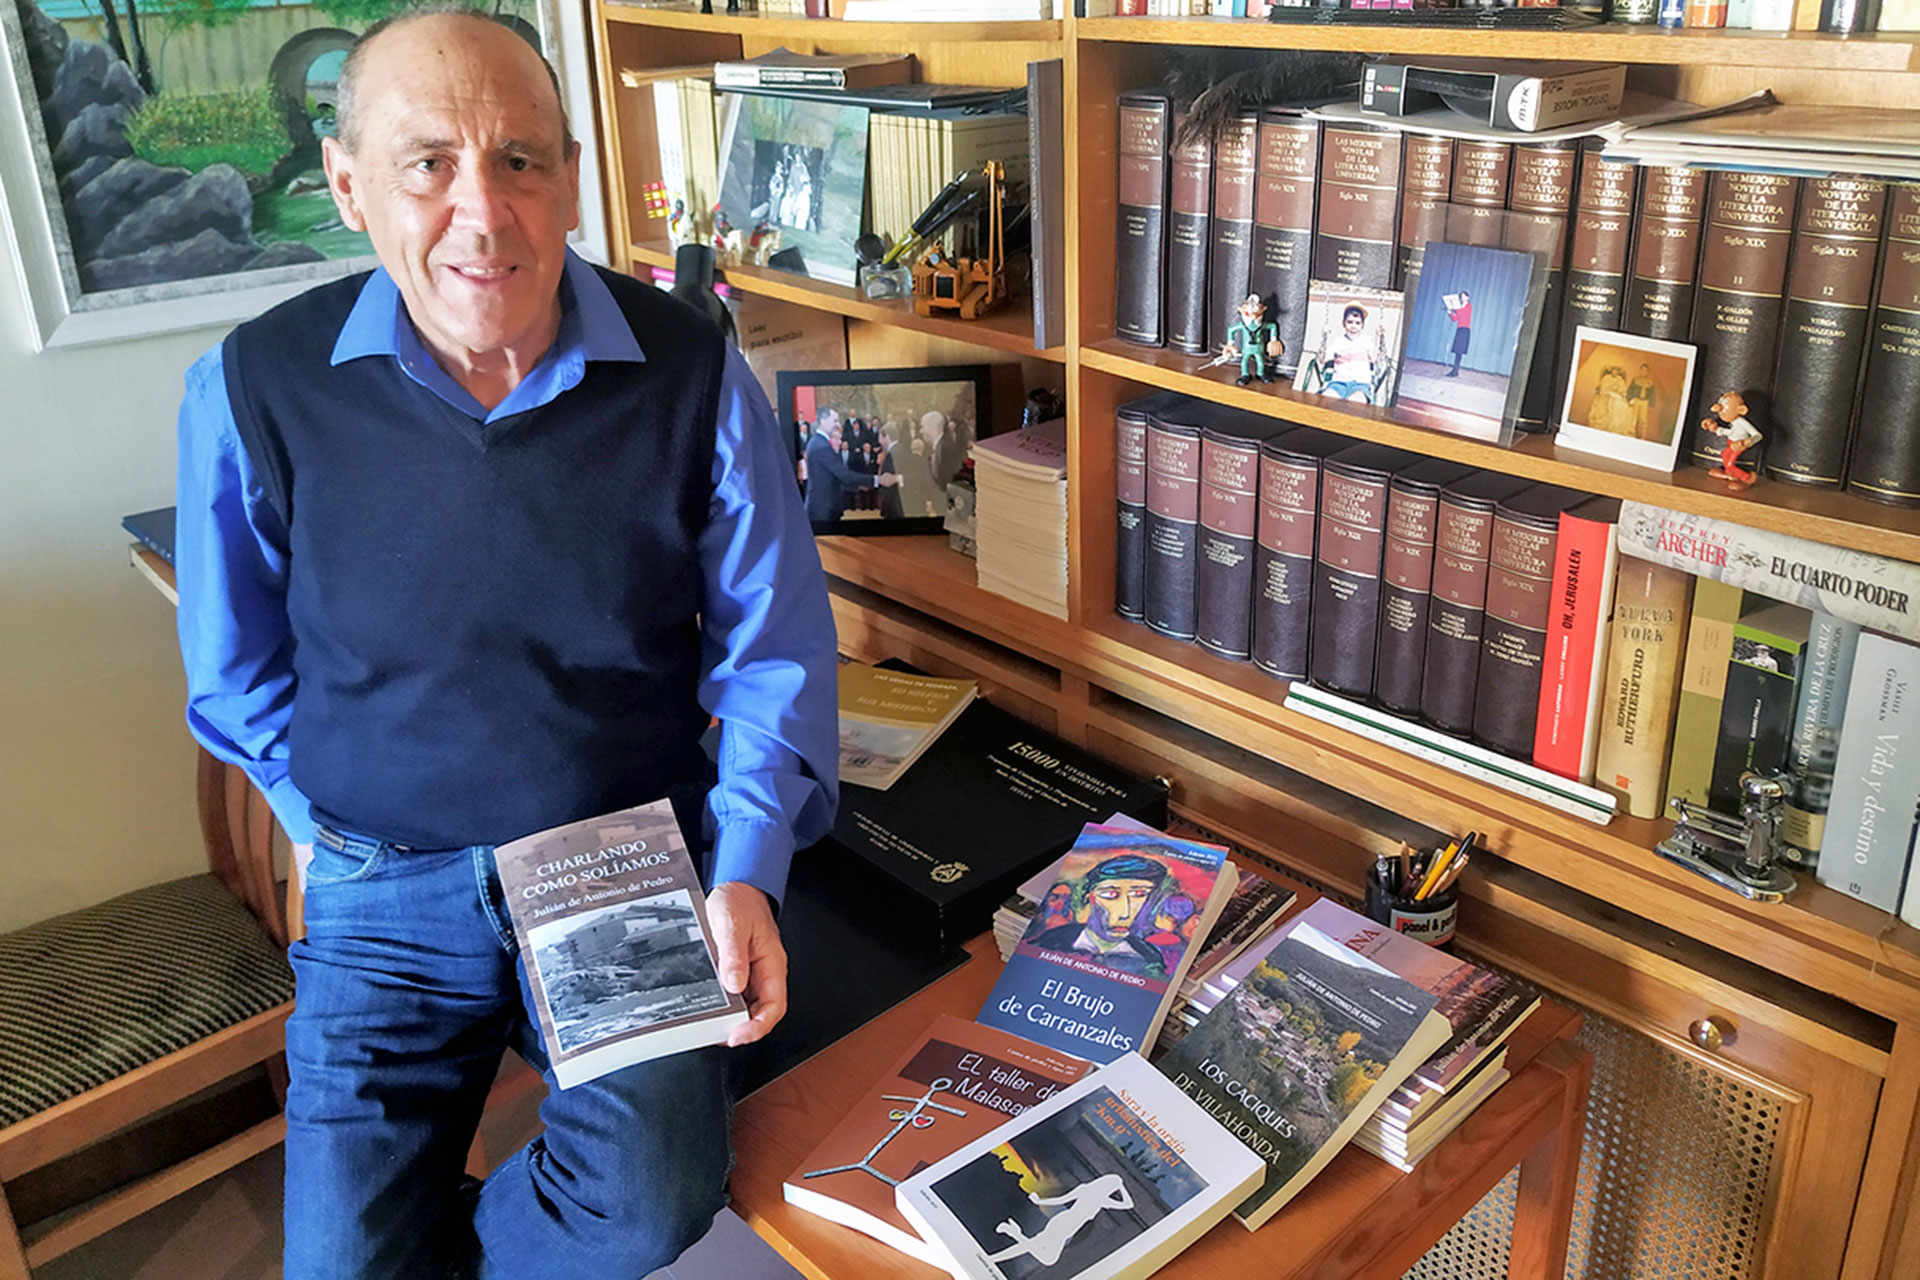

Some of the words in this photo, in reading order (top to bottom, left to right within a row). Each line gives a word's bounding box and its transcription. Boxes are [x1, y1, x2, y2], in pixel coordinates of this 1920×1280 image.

[1342, 148, 1374, 156] NOVELAS
[1350, 139, 1382, 149] MEJORES
[1334, 162, 1380, 174] LITERATURA
[1540, 176, 1552, 185] LA
[1605, 181, 1616, 189] LA
[1722, 173, 1738, 182] LAS
[1740, 174, 1790, 186] MEJORES
[1830, 181, 1883, 192] MEJORES
[1354, 193, 1368, 202] XIX
[1729, 183, 1777, 195] NOVELAS
[1818, 190, 1870, 201] NOVELAS
[1719, 201, 1784, 214] LITERATURA
[1752, 195, 1766, 203] LA
[1824, 200, 1839, 209] DE
[1843, 202, 1858, 210] LA
[1720, 211, 1778, 224] UNIVERSAL
[1806, 208, 1877, 222] LITERATURA
[1601, 221, 1619, 230] XIX
[1668, 229, 1687, 237] XIX
[1808, 218, 1871, 232] UNIVERSAL
[1724, 235, 1744, 246] Siglo
[1746, 239, 1766, 248] XIX
[1811, 244, 1834, 255] Siglo
[1836, 247, 1858, 257] XIX
[1823, 287, 1834, 295] 12
[1659, 519, 1731, 544] JEFFREY
[1521, 547, 1532, 556] LA
[1656, 531, 1728, 567] ARCHER
[1459, 562, 1474, 572] XIX
[1520, 582, 1534, 593] XIX
[1565, 549, 1582, 612] JERUSALÉN
[1770, 556, 1788, 576] EL
[1790, 558, 1850, 595] CUARTO
[1855, 581, 1909, 614] PODER
[1562, 613, 1575, 630] OH,
[1620, 605, 1675, 625] NUEVA
[1622, 625, 1664, 642] YORK
[1816, 624, 1831, 660] CRUZ
[1828, 626, 1843, 676] PRODIGIOS
[1814, 663, 1824, 677] LA
[1811, 677, 1821, 697] DE
[1616, 678, 1628, 728] EDWARD
[1624, 649, 1644, 746] RUTHERFURD
[1801, 697, 1819, 740] RIVERA
[1007, 742, 1060, 769] 15000
[1871, 730, 1899, 773] Vida
[1861, 774, 1880, 793] y
[1854, 792, 1886, 864] destino
[536, 840, 647, 877] CHARLANDO
[522, 874, 578, 900] COMO
[580, 851, 670, 883] SOLÍAMOS
[533, 901, 566, 920] Julián
[568, 896, 582, 908] de
[583, 885, 625, 902] Antonio
[627, 881, 641, 893] de
[642, 874, 674, 890] Pedro
[1402, 919, 1430, 933] panel
[1039, 951, 1062, 962] JULIÁN
[1063, 957, 1072, 966] DE
[1073, 961, 1109, 976] ANTONIO
[1109, 971, 1118, 980] DE
[1120, 974, 1145, 986] PEDRO
[1041, 979, 1061, 999] El
[1063, 984, 1114, 1016] Brujo
[1296, 973, 1316, 988] JULIÁN
[1316, 985, 1325, 993] DE
[1325, 991, 1352, 1011] ANTONIO
[1351, 1007, 1360, 1016] DE
[1360, 1013, 1381, 1029] PEDRO
[999, 995, 1020, 1016] de
[1026, 1005, 1133, 1051] Carranzales
[1455, 1043, 1467, 1053] de
[988, 1066, 1034, 1092] taller
[1198, 1058, 1227, 1083] LOS
[1226, 1076, 1297, 1140] CACIQUES
[1120, 1089, 1141, 1111] Sara
[1147, 1115, 1158, 1128] la
[1174, 1072, 1199, 1097] DE
[1197, 1089, 1281, 1164] VILLAHONDA
[1159, 1150, 1180, 1167] del
